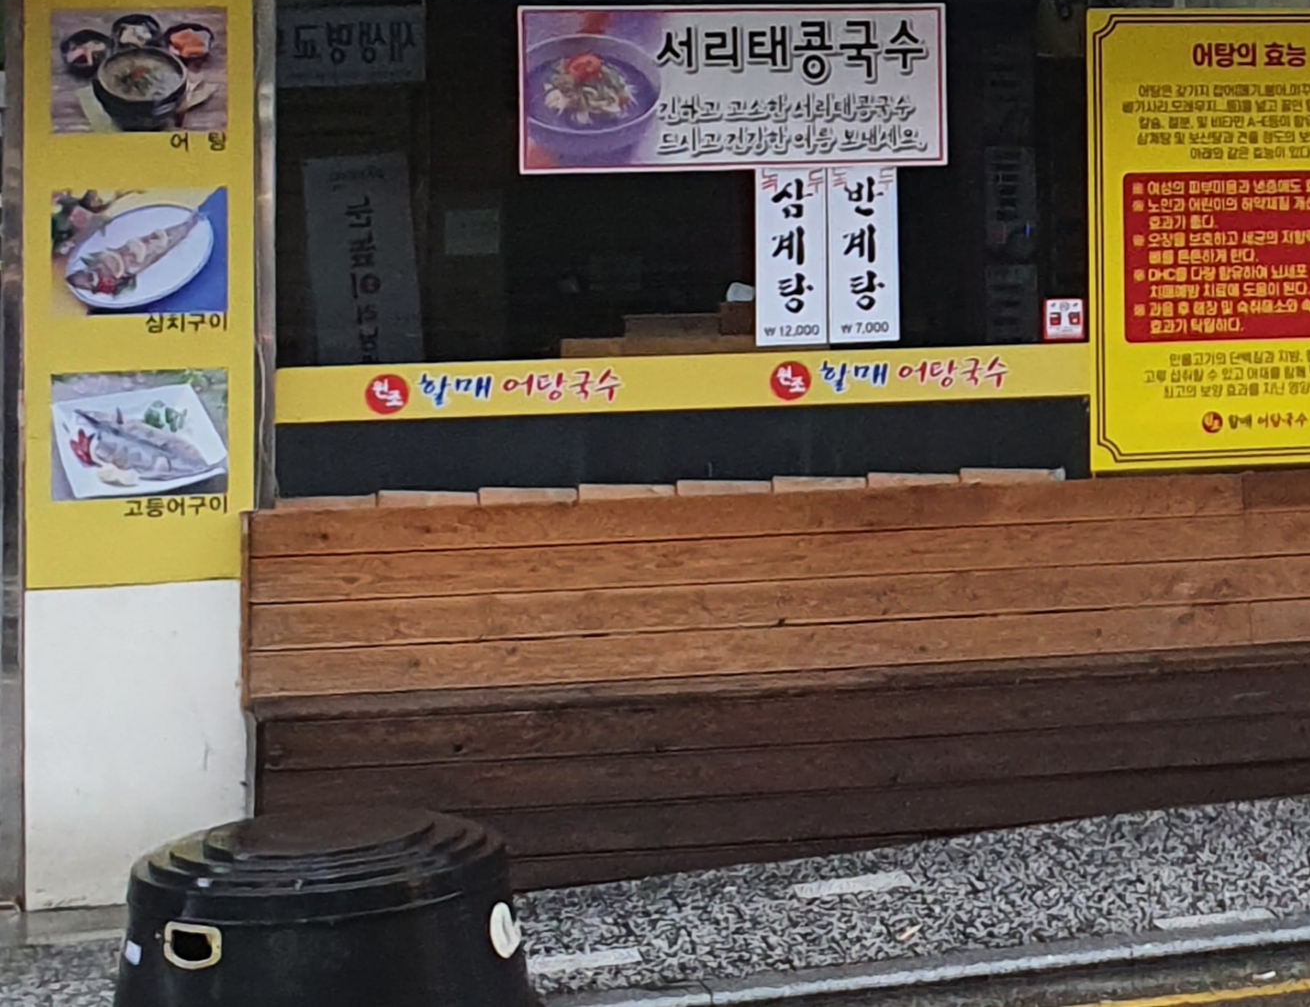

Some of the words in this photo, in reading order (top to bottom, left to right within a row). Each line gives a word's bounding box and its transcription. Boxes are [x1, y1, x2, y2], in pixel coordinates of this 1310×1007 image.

[656, 19, 928, 82] 서리태콩국수
[1193, 43, 1257, 67] 어탕의
[1265, 43, 1306, 67] 효능
[771, 178, 813, 314] 삼계탕
[843, 176, 885, 311] 반계탕
[419, 373, 492, 407] 할매
[502, 368, 623, 402] 어탕국수
[819, 361, 888, 392] 할매
[898, 355, 1009, 388] 어탕국수
[124, 496, 228, 517] 고등어구이
